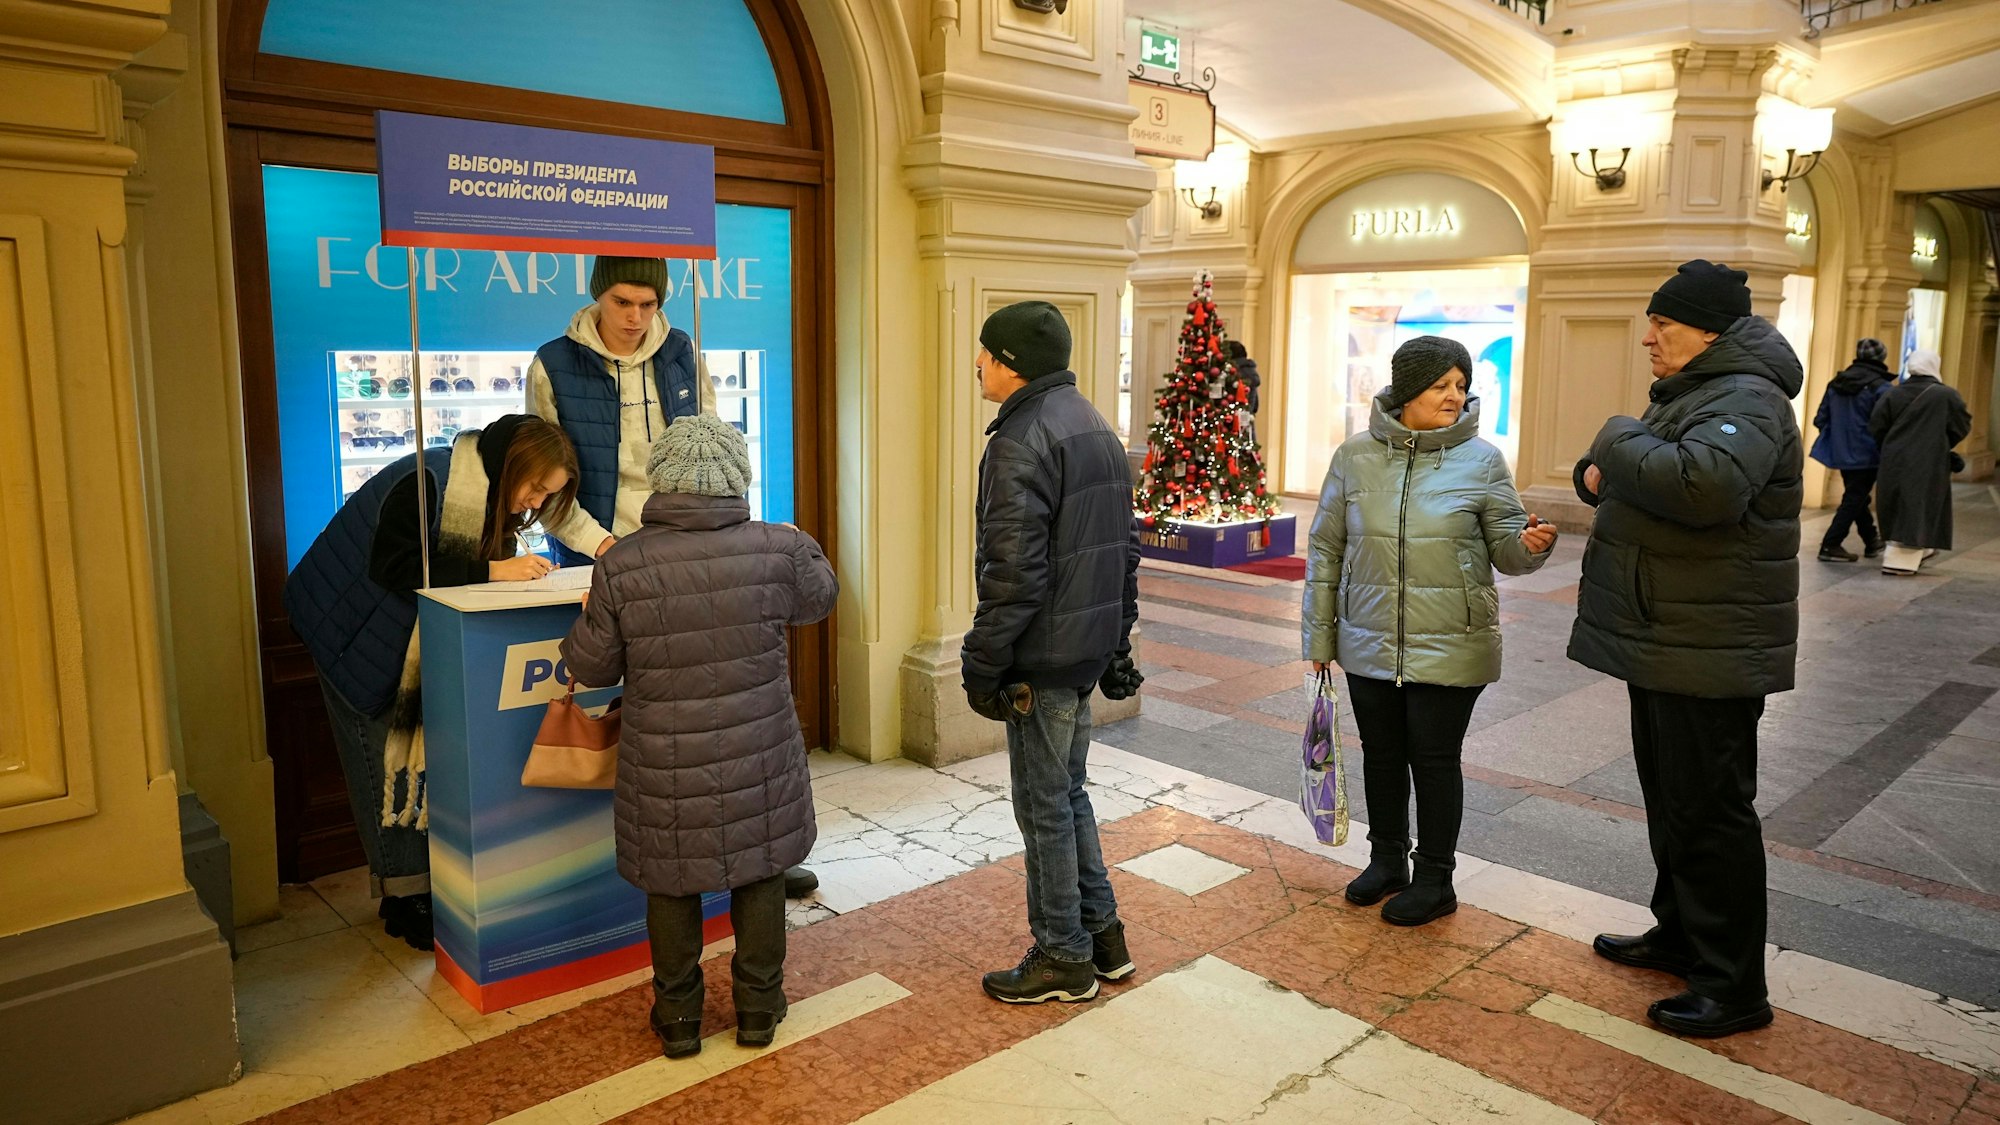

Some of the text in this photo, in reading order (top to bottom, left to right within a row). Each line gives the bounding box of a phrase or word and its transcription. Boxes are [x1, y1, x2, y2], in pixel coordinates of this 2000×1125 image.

[1154, 103, 1163, 121] 3
[447, 153, 638, 185] ВЫБОРЫ ПРЕЗИДЕНТА
[448, 178, 669, 211] РОССИЙСКОЙ ФЕДЕРАЦИИ
[1350, 207, 1455, 237] FURLA
[317, 236, 458, 292] FOR
[662, 256, 763, 302] AKE
